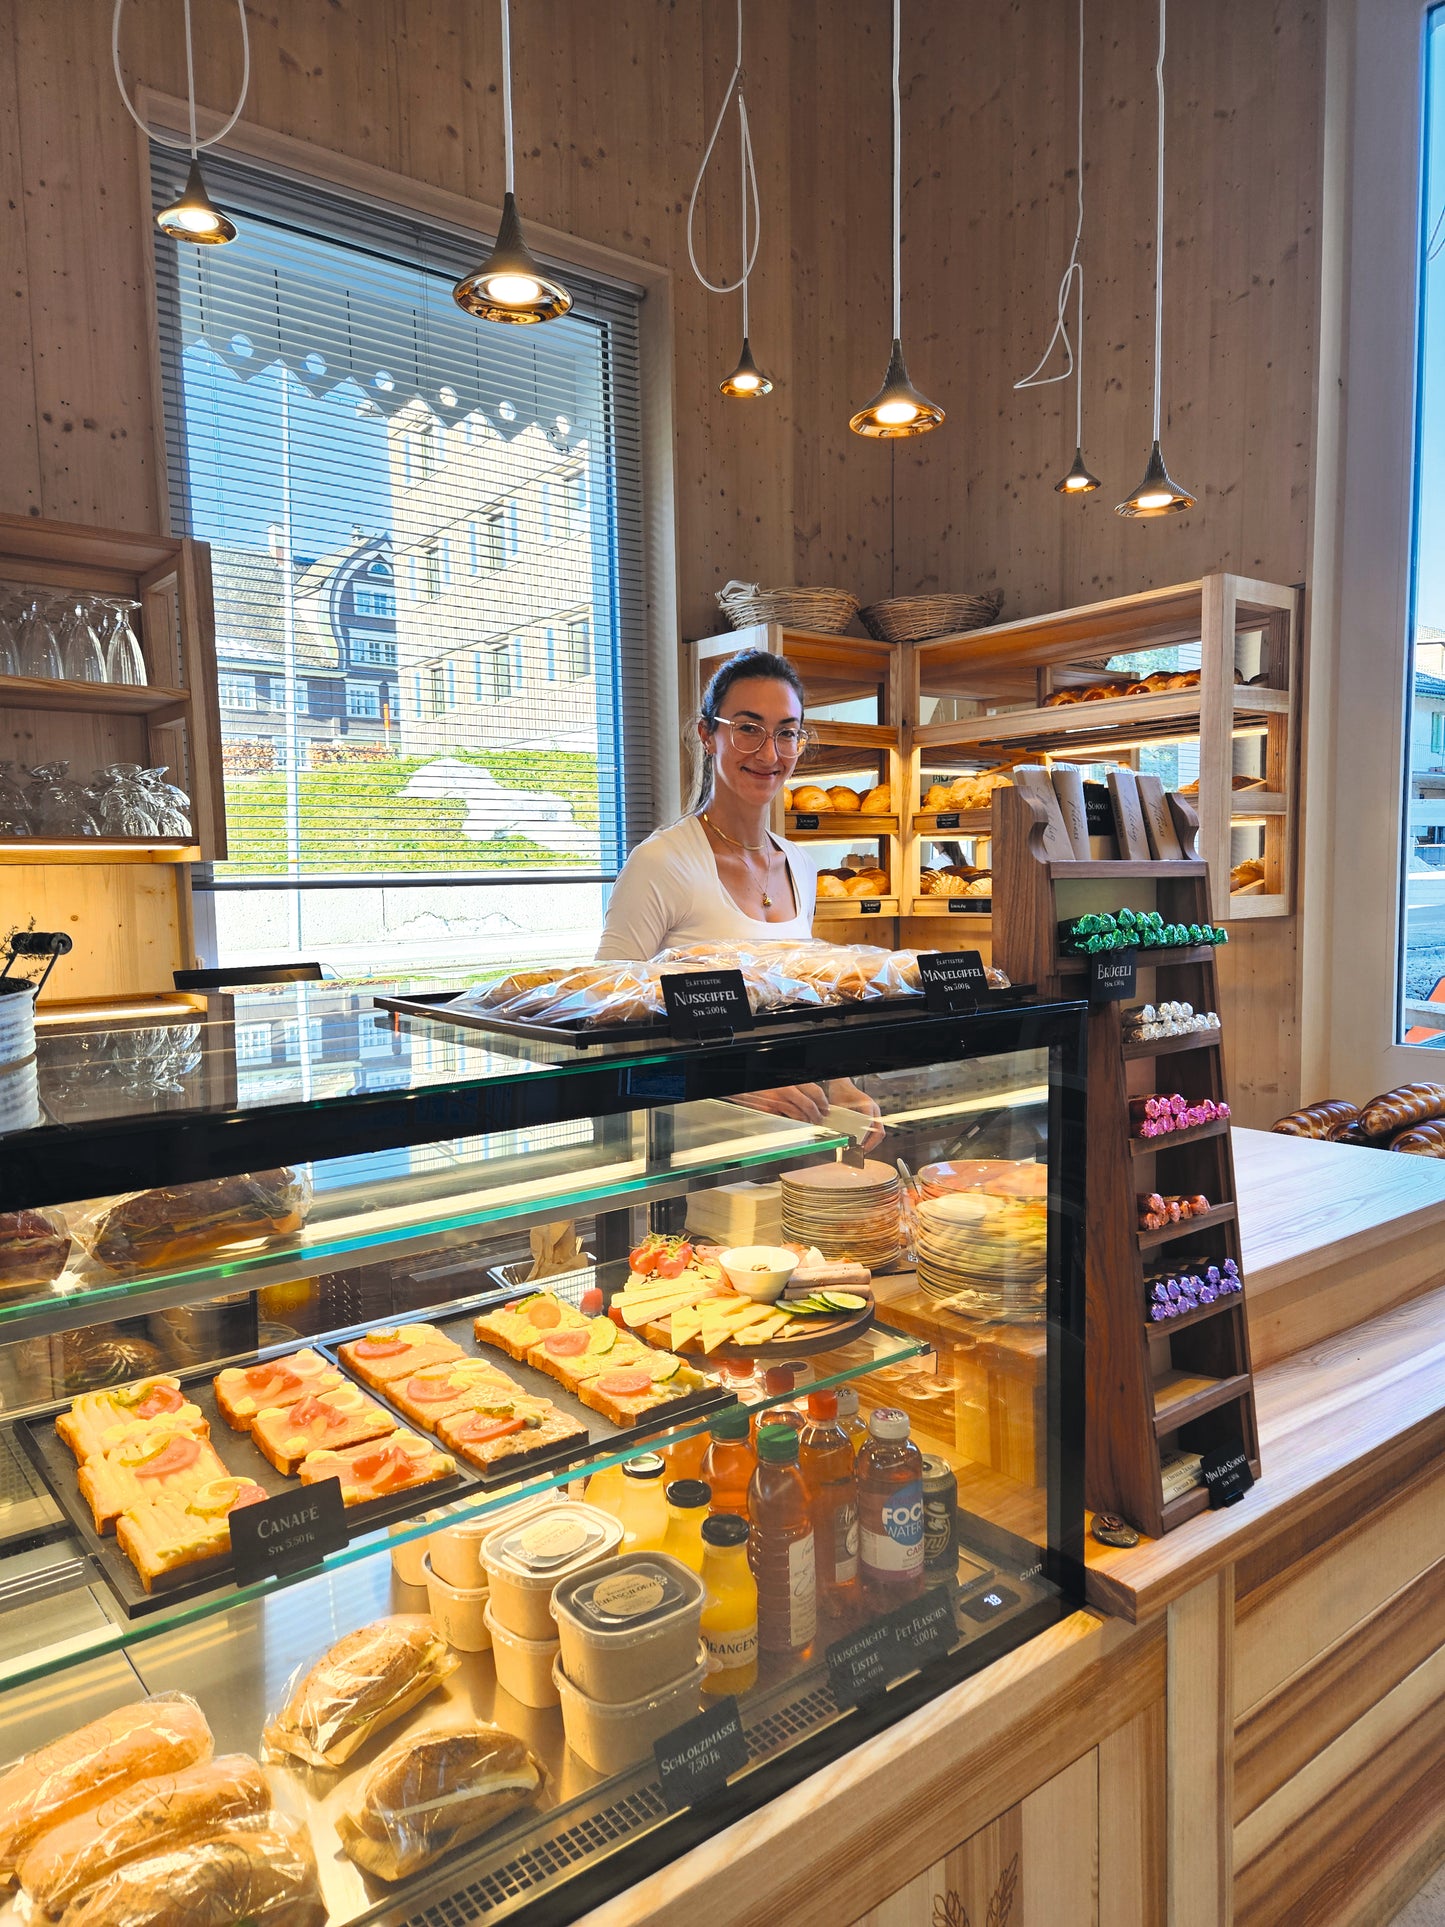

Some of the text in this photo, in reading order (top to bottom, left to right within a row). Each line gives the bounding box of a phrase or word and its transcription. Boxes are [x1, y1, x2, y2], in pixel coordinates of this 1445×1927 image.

[673, 990, 739, 1007] NUSSGIPFEL
[257, 1502, 320, 1539] CANAPÉ
[882, 1502, 924, 1525] FOC
